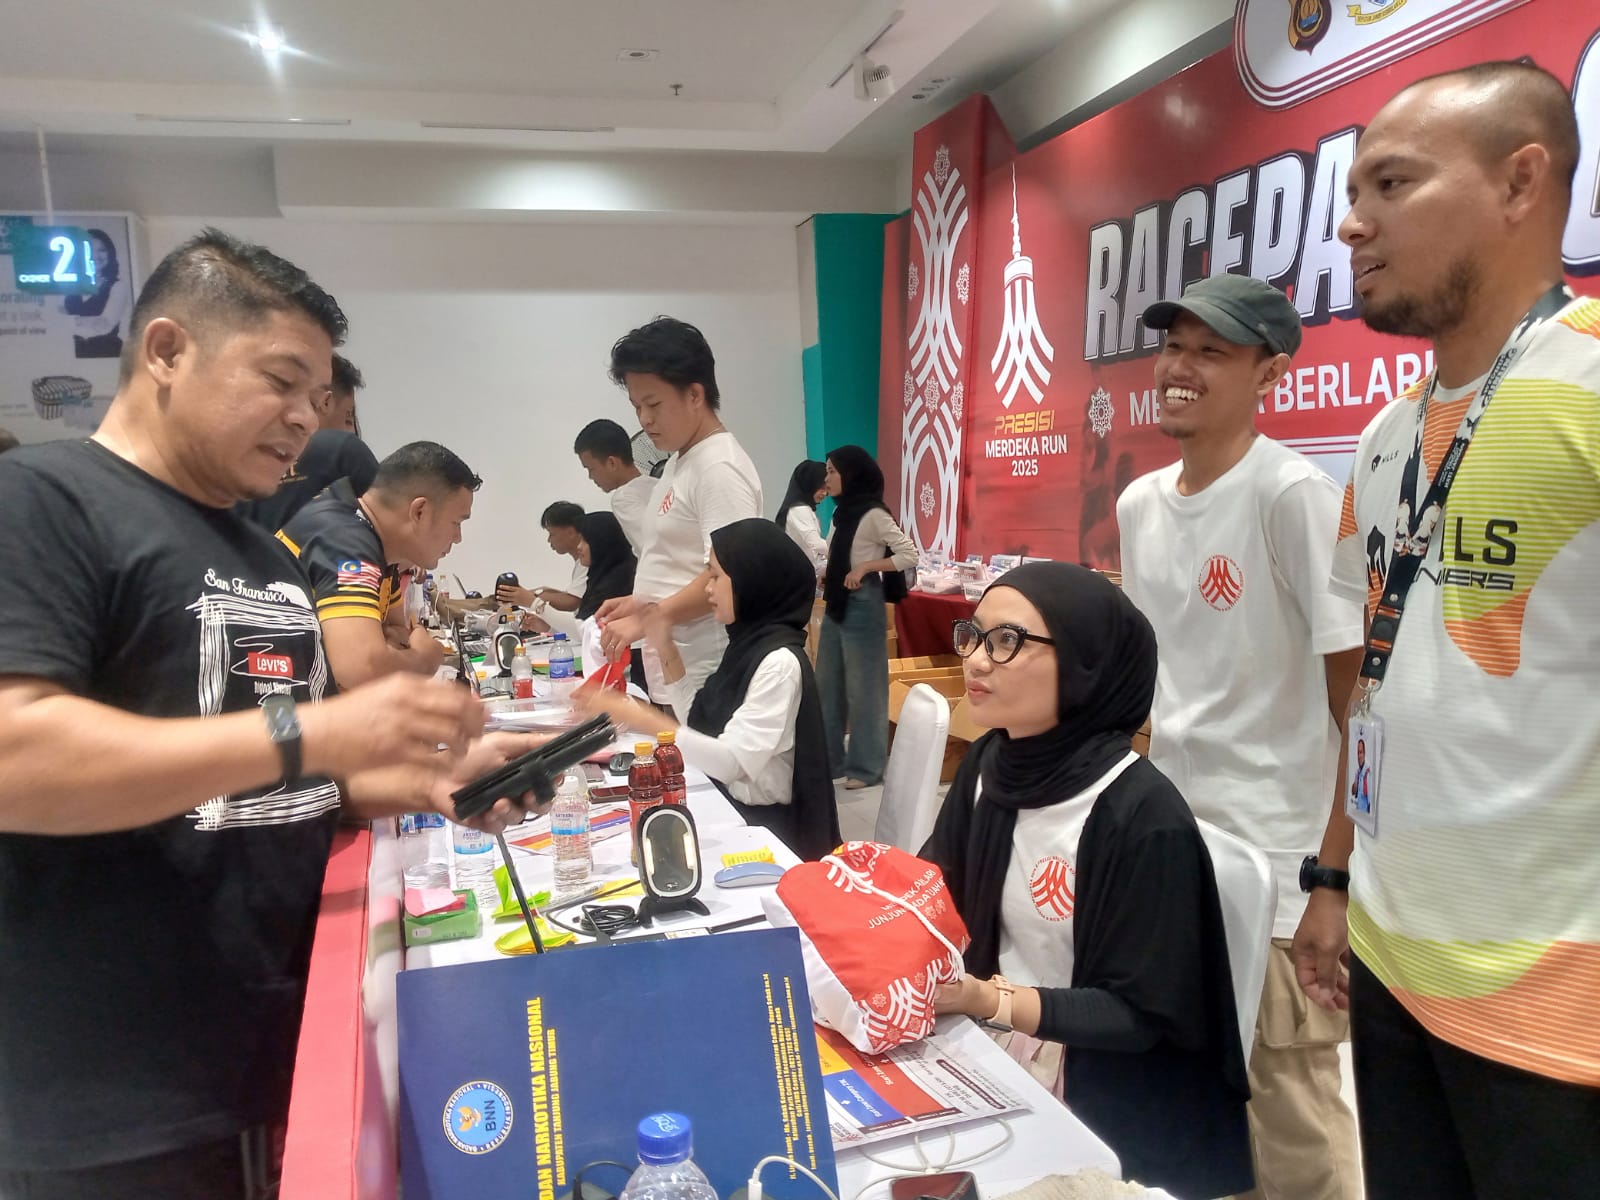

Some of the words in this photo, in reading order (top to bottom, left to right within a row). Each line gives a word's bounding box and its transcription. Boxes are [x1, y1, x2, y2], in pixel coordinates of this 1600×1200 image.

[1083, 126, 1357, 361] RACEPA
[994, 409, 1055, 436] PRESISI
[985, 436, 1040, 458] MERDEKA
[1041, 434, 1068, 454] RUN
[1011, 459, 1039, 477] 2025
[204, 568, 230, 592] San
[232, 577, 287, 603] Francisco
[868, 907, 906, 929] JUNJUN
[526, 997, 546, 1072] NASIONAL
[547, 1028, 557, 1056] TIMUR
[549, 1058, 560, 1092] JABUNG
[484, 1099, 497, 1132] BNN
[531, 1074, 552, 1165] NARKOTIKA
[551, 1093, 563, 1132] TANJUNG
[554, 1133, 566, 1186] KABUPATEN
[537, 1168, 554, 1200] DAN
